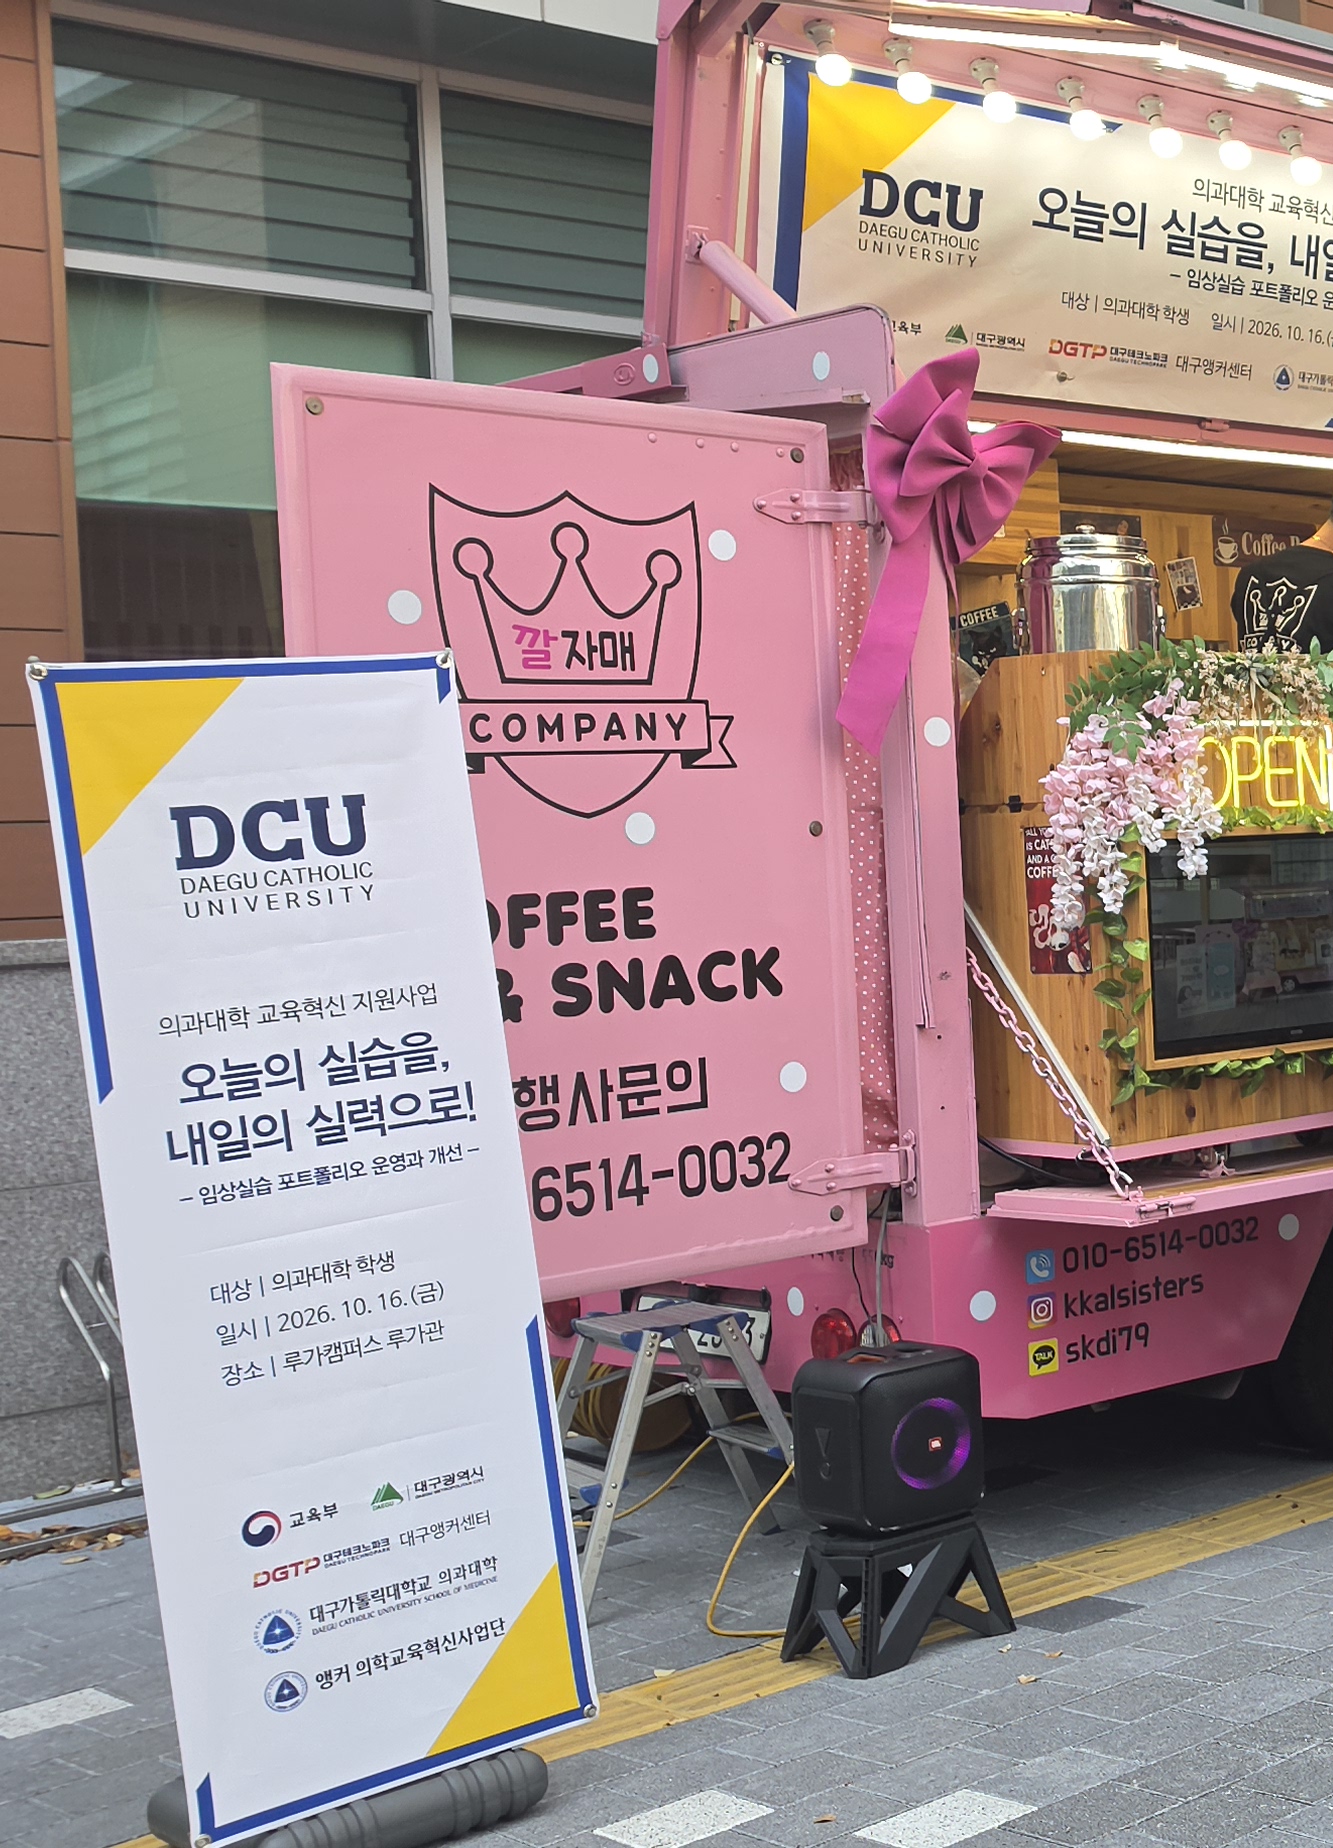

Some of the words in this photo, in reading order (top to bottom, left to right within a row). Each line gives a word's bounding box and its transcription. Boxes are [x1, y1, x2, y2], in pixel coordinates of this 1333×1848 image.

[859, 168, 984, 232] DCU
[1192, 177, 1265, 213] 의과대학
[858, 220, 908, 241] DAEGU
[911, 223, 980, 252] CATHOLIC
[1032, 186, 1147, 251] 오늘의
[1161, 208, 1275, 273] 실습을,
[858, 237, 978, 268] UNIVERSITY
[1061, 290, 1090, 313] 대상
[1102, 296, 1160, 323] 의과대학
[1163, 304, 1190, 327] 학생
[1186, 269, 1246, 296] 임상실습
[1250, 280, 1319, 308] 포트폴리오
[976, 332, 1026, 348] 대구광역시
[1048, 338, 1107, 360] DGTP
[1211, 312, 1237, 334] 일시
[1247, 318, 1282, 339] 2026.
[1286, 324, 1305, 342] 10.
[1110, 346, 1168, 362] 대구테크노파크
[1175, 354, 1253, 381] 대구앵커센터
[960, 606, 999, 627] COFFEE
[512, 624, 636, 672] 깔자매
[469, 711, 687, 743] COMPANY
[1197, 735, 1329, 809] OPEN
[169, 794, 367, 871] DCU
[180, 871, 258, 895] DAEGU
[263, 861, 374, 890] CATHOLIC
[1026, 865, 1060, 878] COFFE
[184, 884, 375, 919] UNIVERSITY
[551, 946, 784, 1018] SNACK
[158, 1005, 250, 1038] 의과대학
[256, 997, 346, 1027] 교육혁신
[353, 982, 438, 1014] 지원사업
[178, 1047, 306, 1105] 오늘의
[318, 1030, 450, 1087] 실습을,
[511, 1056, 709, 1133] 행사문의
[165, 1108, 293, 1167] 내일의
[306, 1080, 477, 1148] 실력으로!
[198, 1174, 273, 1207] 임상실습
[278, 1161, 368, 1192] 포트폴리오
[371, 1151, 424, 1177] 운영과
[429, 1143, 463, 1167] 개선
[530, 1131, 792, 1222] 6514-0032
[1062, 1216, 1260, 1274] 010-6514-0032
[210, 1278, 252, 1306] 대상
[271, 1257, 352, 1293] 의과대학
[356, 1249, 396, 1275] 학생
[1063, 1271, 1205, 1320] kkalsisters
[216, 1316, 258, 1348] 일시
[277, 1304, 335, 1333] 2026.
[341, 1297, 373, 1323] 10.
[1065, 1322, 1151, 1364] skdi79
[220, 1359, 264, 1388] 장소
[282, 1333, 383, 1373] 루가캠퍼스
[387, 1319, 445, 1355] 루가관
[414, 1465, 484, 1493] 대구광역시
[289, 1502, 338, 1529] 교육부
[399, 1509, 491, 1547] 대구앵커센터
[253, 1556, 320, 1588] DGTP
[323, 1537, 390, 1563] 대구테크노파크
[309, 1575, 433, 1623] 대구가톨릭대학교
[438, 1555, 498, 1586] 의과대학
[311, 1622, 338, 1636] DAEGU
[339, 1610, 376, 1627] CATHOLIC
[378, 1598, 423, 1617] UNIVERSITY
[423, 1589, 453, 1604] SCHOOL
[453, 1586, 463, 1595] OF
[464, 1575, 499, 1592] MEDICINE
[315, 1664, 351, 1691] 앵커
[355, 1617, 506, 1677] 의학교육혁신사업단
